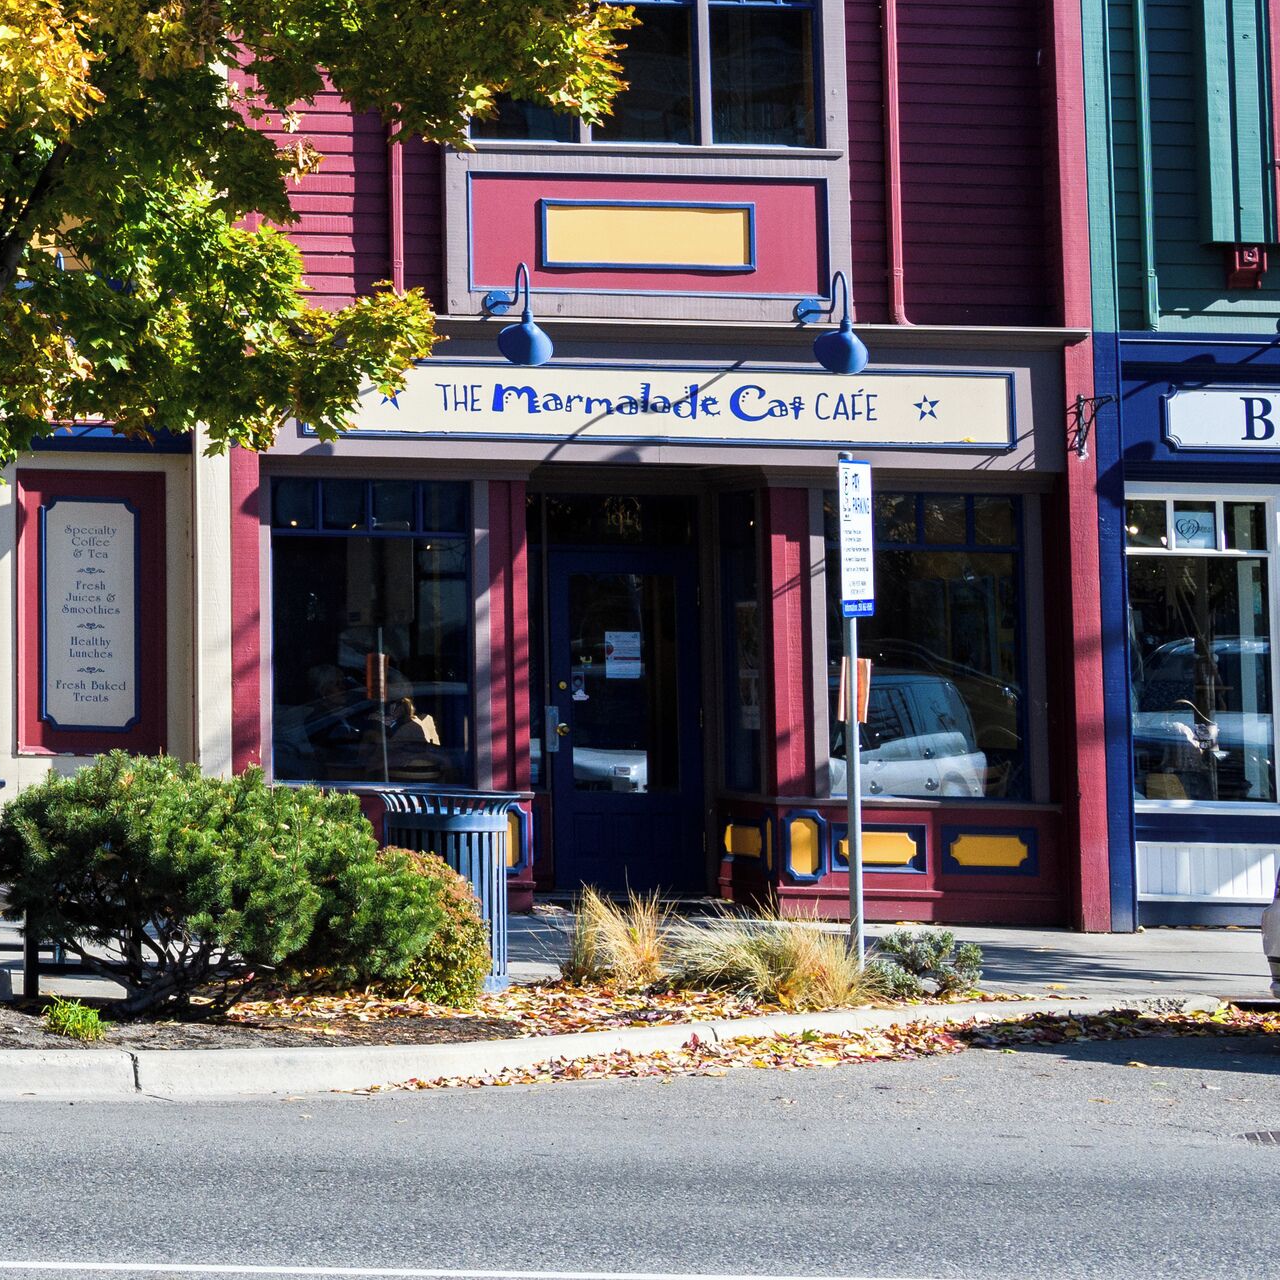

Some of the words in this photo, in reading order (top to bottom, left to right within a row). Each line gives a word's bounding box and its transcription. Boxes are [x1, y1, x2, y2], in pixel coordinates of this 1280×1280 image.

[435, 383, 482, 411] THE
[492, 383, 721, 420] Marmalade
[729, 384, 805, 421] Cat
[815, 389, 878, 420] CAFÉ
[64, 524, 118, 538] Specialty
[71, 536, 111, 547] Coffee
[73, 549, 83, 559] &
[88, 549, 109, 559] Tea
[75, 580, 106, 591] Fresh
[65, 592, 102, 602] Juices
[106, 593, 117, 603] &
[61, 604, 121, 615] Smoothies
[70, 636, 112, 650] Healthy
[69, 648, 113, 659] Lunches
[55, 679, 87, 691] Fresh
[91, 680, 127, 692] Baked
[72, 691, 110, 703] Treats
